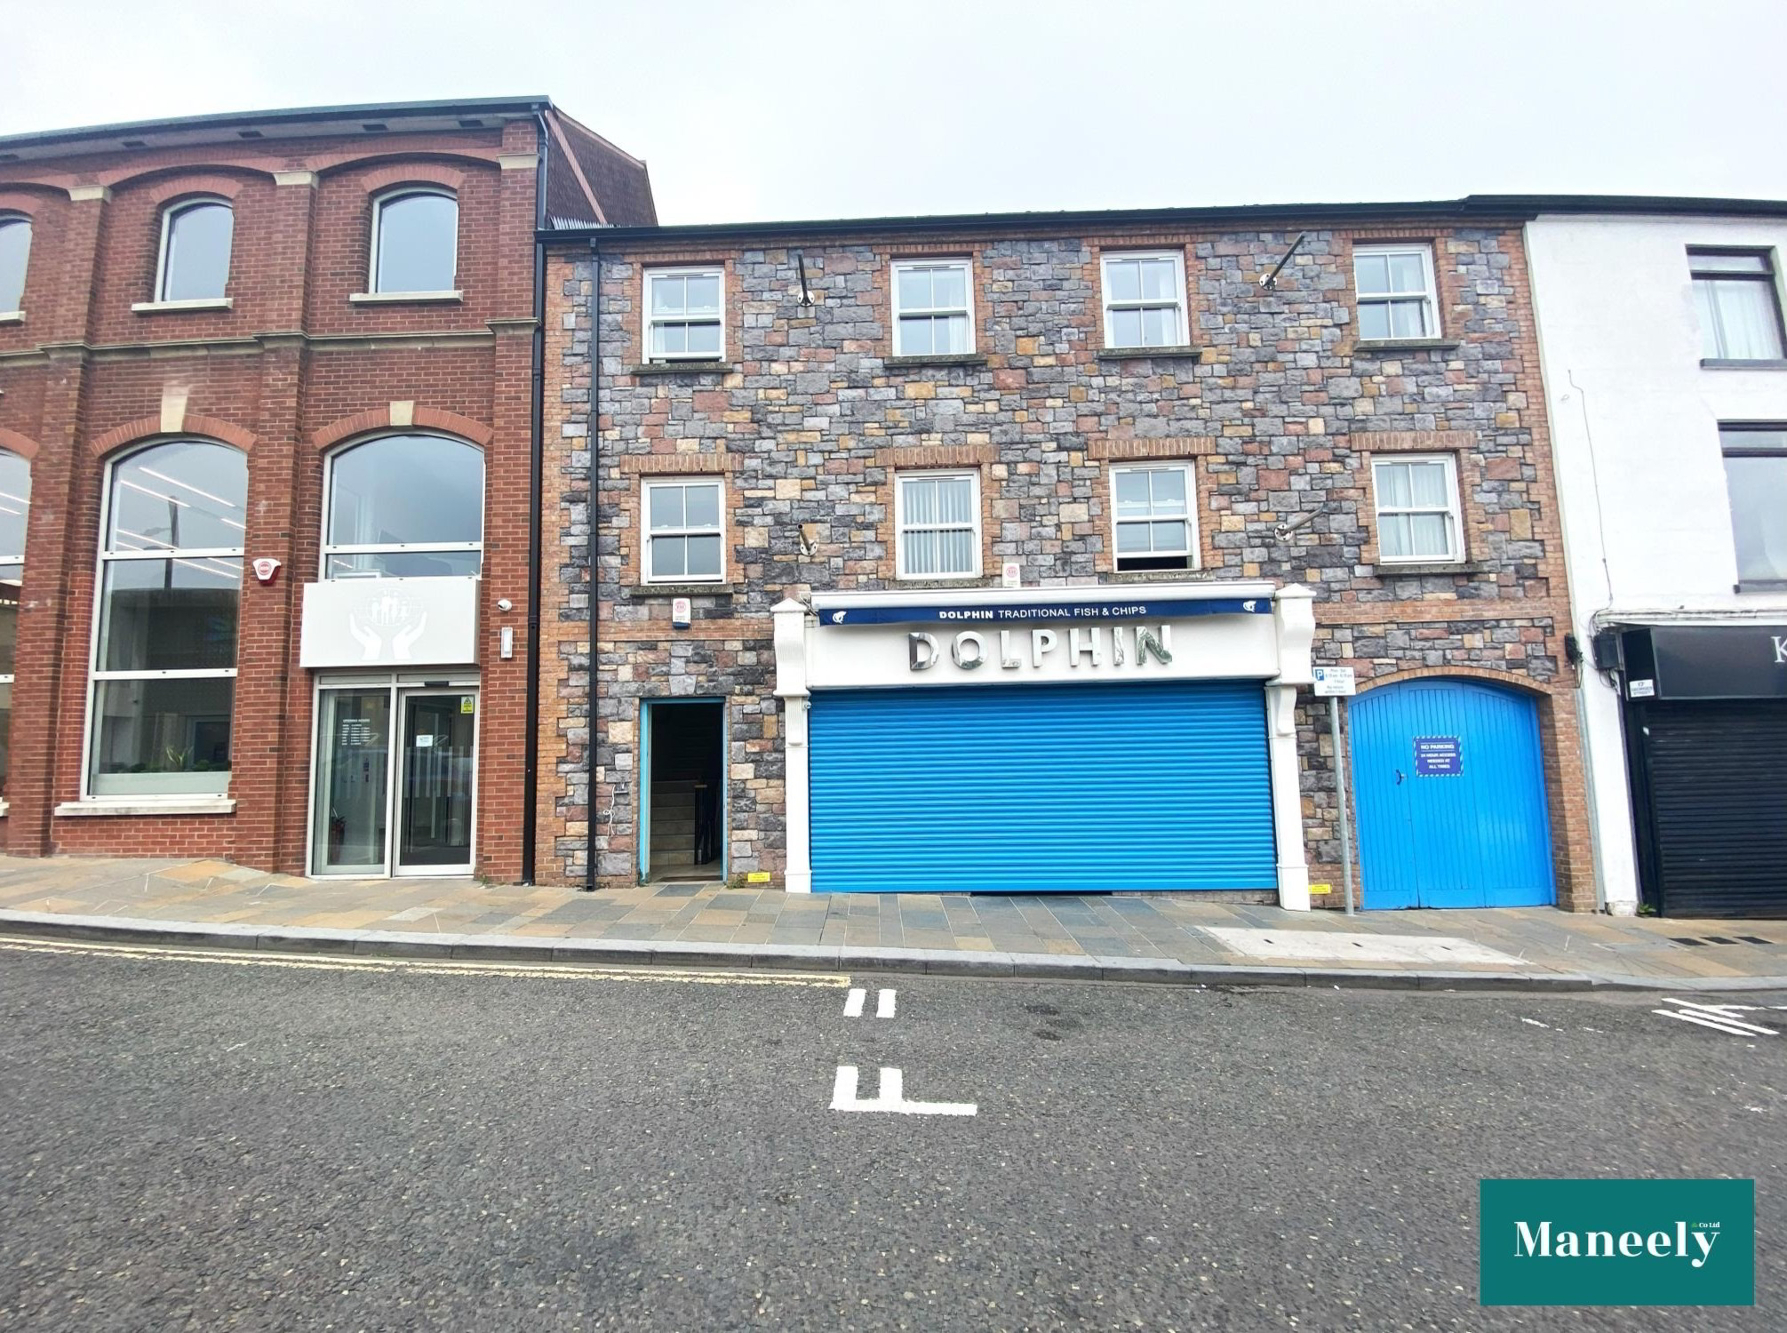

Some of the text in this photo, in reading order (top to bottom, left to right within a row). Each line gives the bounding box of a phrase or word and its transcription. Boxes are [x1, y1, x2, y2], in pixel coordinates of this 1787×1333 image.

[939, 606, 1147, 620] DOLPHIN TRADITIONAL FISH & CHIPS
[908, 624, 1173, 671] DOLPHIN
